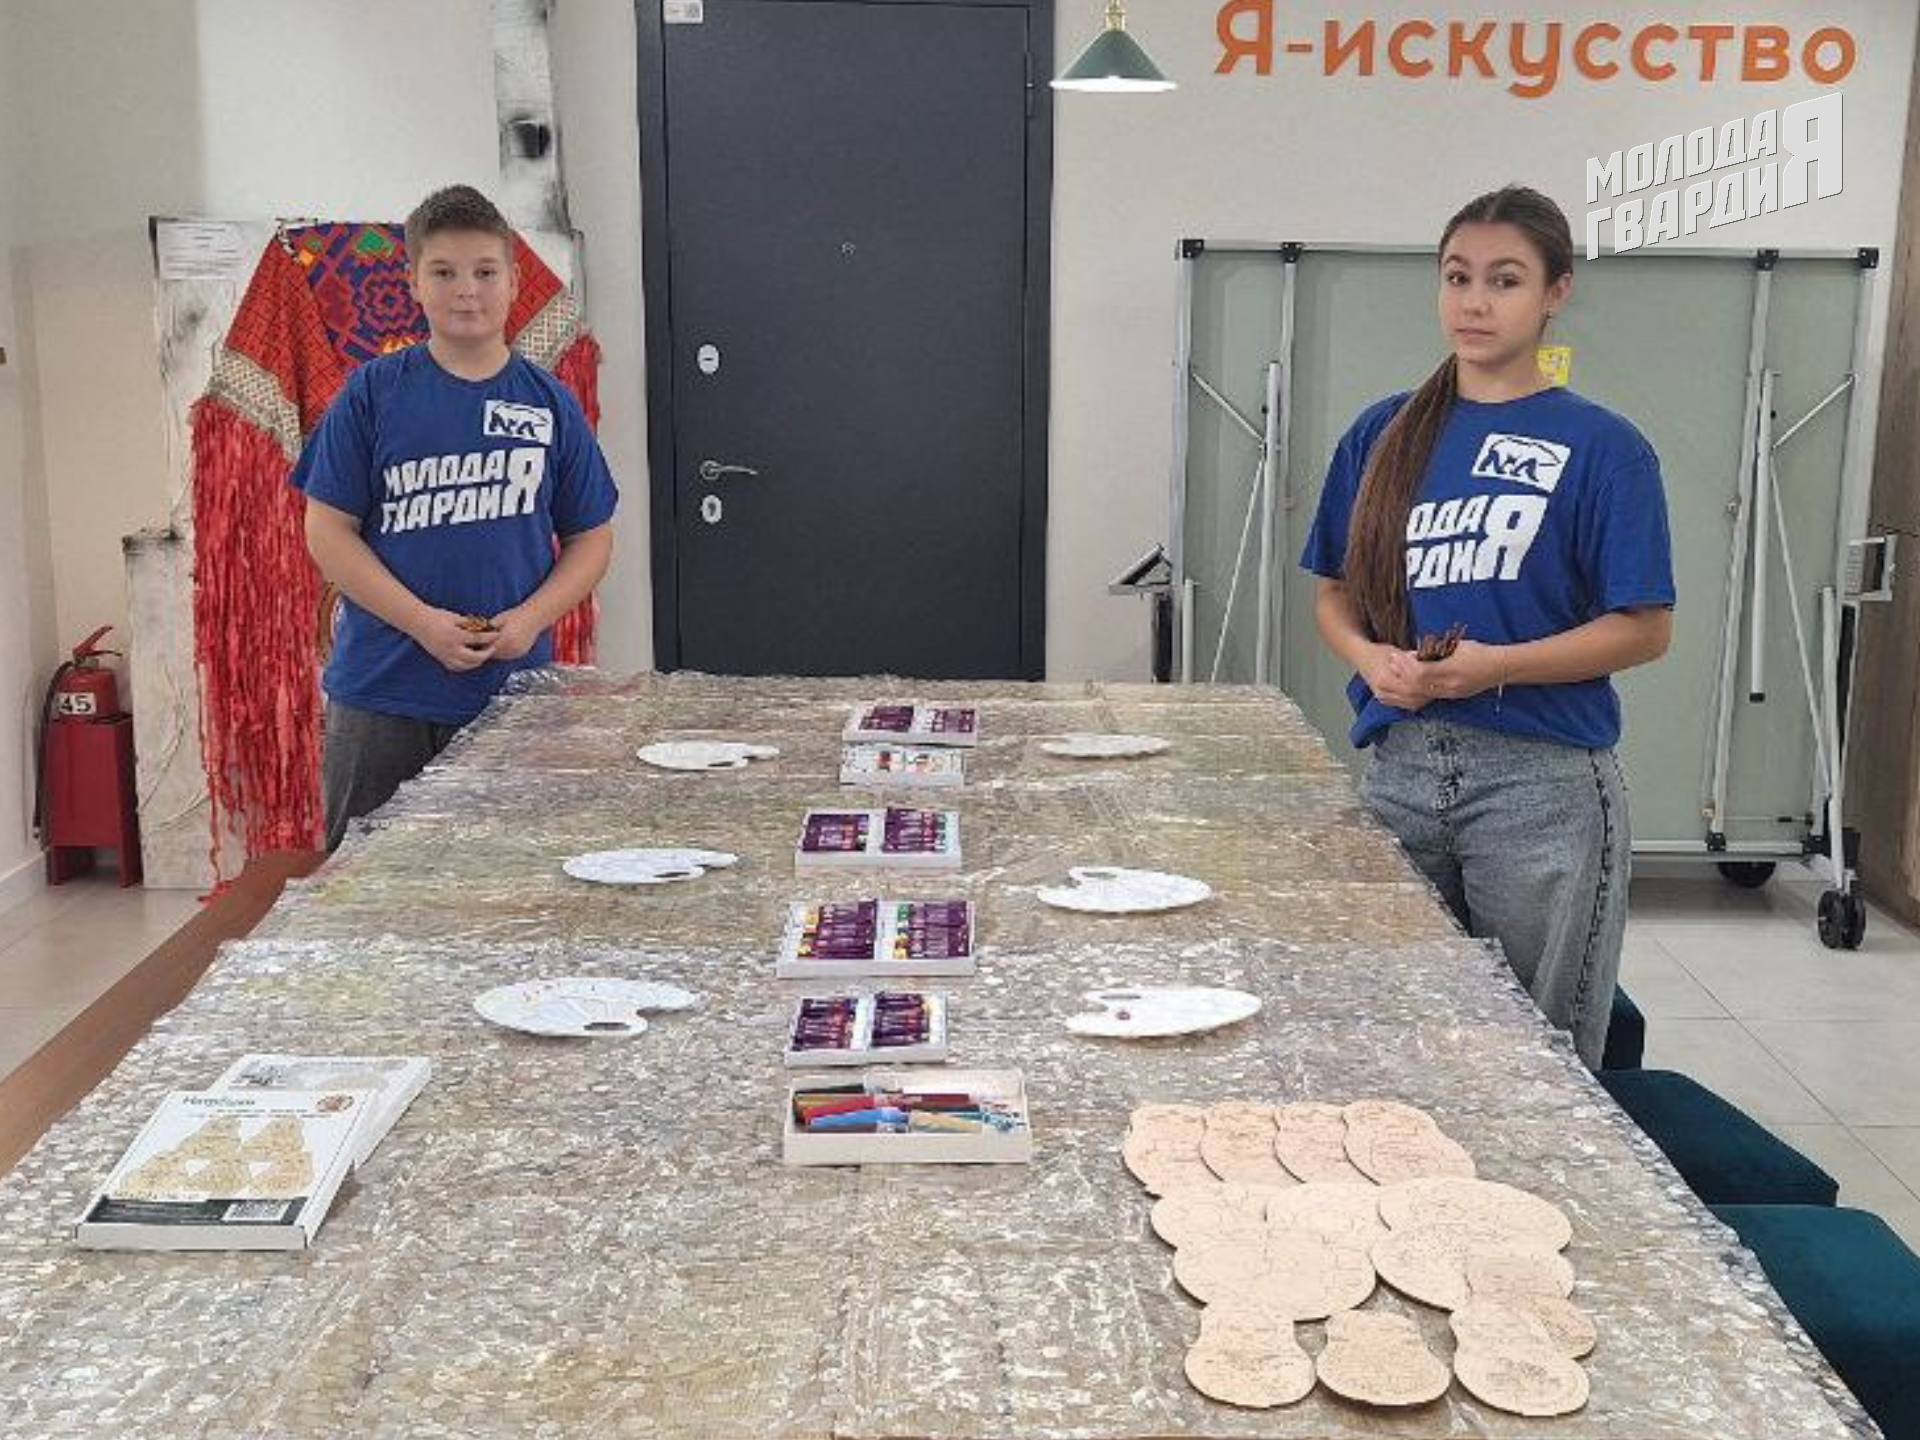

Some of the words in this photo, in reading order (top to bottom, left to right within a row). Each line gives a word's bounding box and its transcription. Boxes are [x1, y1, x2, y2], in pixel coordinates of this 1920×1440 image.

[1214, 0, 1857, 97] Я-искусство
[1406, 494, 1549, 580] ОДАЯ
[1406, 494, 1549, 591] РДИЯ
